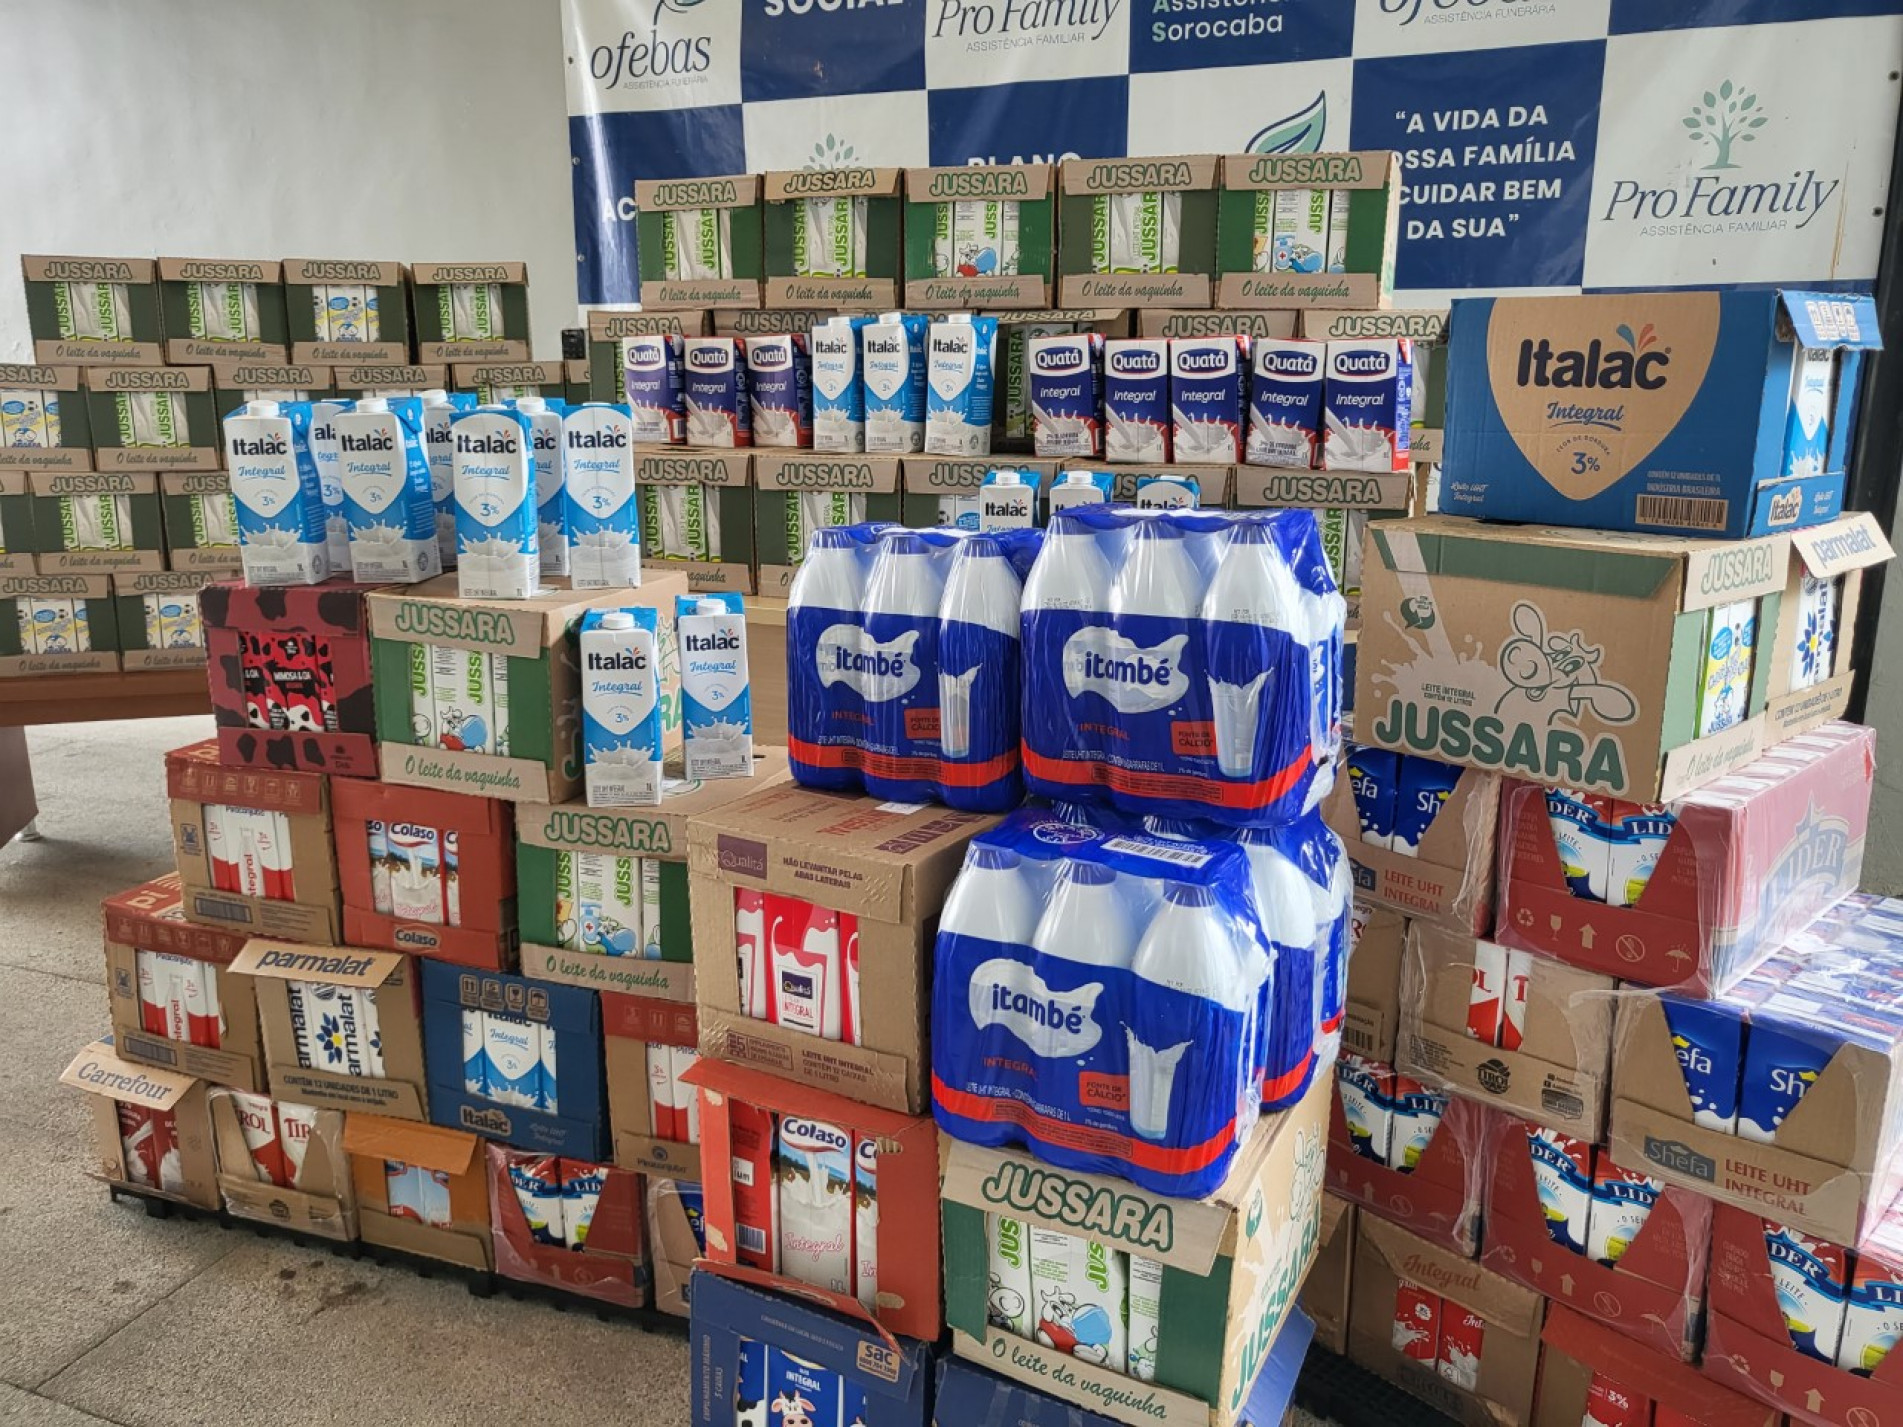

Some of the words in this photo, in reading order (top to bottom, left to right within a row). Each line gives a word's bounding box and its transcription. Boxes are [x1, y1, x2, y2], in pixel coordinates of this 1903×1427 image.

[932, 0, 994, 37] Pro
[998, 0, 1120, 41] Family
[1424, 10, 1492, 24] ASSISTÊNCIA
[1496, 5, 1555, 18] FUNERÁRIA
[1152, 14, 1283, 42] Sorocaba
[966, 36, 1034, 52] ASSISTÊNCIA
[1036, 32, 1085, 46] FAMILIAR
[590, 30, 711, 90] ofebas
[623, 78, 670, 89] ASSISTÊNCIA
[1433, 108, 1499, 132] VIDA
[1509, 105, 1548, 127] DA
[1463, 136, 1576, 166] FAMÍLIA
[1087, 162, 1192, 189] JUSSARA
[1249, 157, 1362, 184] JUSSARA
[783, 171, 874, 194] JUSSARA
[930, 172, 1028, 197] JUSSARA
[1399, 182, 1496, 205] CUIDAR
[1503, 178, 1562, 200] BEM
[654, 181, 736, 206] JUSSARA
[1603, 179, 1676, 222] Pro
[1682, 170, 1839, 230] Family
[1407, 220, 1444, 239] DA
[1640, 223, 1726, 238] ASSISTÊNCIA
[1729, 219, 1788, 234] FAMILIAR
[45, 261, 132, 279] JUSSARA
[181, 262, 263, 279] JUSSARA
[302, 262, 381, 279] JUSSARA
[433, 266, 508, 282] JUSSARA
[1082, 282, 1092, 296] O
[1094, 282, 1115, 296] leite
[1119, 283, 1132, 296] da
[1134, 282, 1183, 302] vaquinha
[1242, 282, 1252, 296] O
[1255, 281, 1277, 296] leite
[1281, 283, 1295, 296] da
[1297, 282, 1350, 300] vaquinha
[605, 318, 683, 338] JUSSARA
[735, 312, 819, 333] JUSSARA
[1162, 315, 1269, 338] JUSSARA
[1329, 316, 1444, 337] JUSSARA
[628, 348, 660, 364] Quatá
[752, 348, 786, 364] Quatá
[815, 340, 847, 355] Italac
[867, 340, 900, 354] Italac
[933, 339, 968, 355] Italac
[691, 351, 727, 366] Quatá
[1036, 348, 1080, 367] Quatá
[1112, 353, 1158, 370] Quatá
[1177, 351, 1226, 369] Quatá
[1264, 353, 1314, 373] Quatá
[1336, 351, 1387, 371] Quatá
[1517, 338, 1669, 390] Italac
[105, 372, 189, 389] JUSSARA
[234, 367, 313, 385] JUSSARA
[350, 368, 427, 383] JUSSARA
[472, 368, 546, 383] JUSSARA
[1009, 330, 1025, 416] JUSSARA
[631, 380, 660, 391] Integral
[692, 382, 726, 394] Integral
[755, 381, 790, 393] Integral
[1547, 402, 1624, 425] Integral
[232, 439, 287, 456] Italac
[341, 435, 393, 452] Italac
[457, 435, 517, 454] Italac
[568, 430, 628, 449] Italac
[238, 464, 286, 477] Integral
[347, 462, 391, 475] Integral
[461, 466, 510, 478] Integral
[573, 459, 620, 472] Integral
[639, 459, 728, 482] JUSSARA
[1571, 452, 1600, 474] 3%
[50, 475, 135, 492] JUSSARA
[776, 463, 873, 488] JUSSARA
[1262, 475, 1381, 503] JUSSARA
[985, 503, 1028, 517] Italac
[1770, 499, 1800, 522] Italac
[1811, 525, 1877, 569] parmalat
[1701, 544, 1772, 595] JUSSARA
[3, 577, 88, 594] JUSSARA
[134, 573, 215, 590] JUSSARA
[396, 601, 514, 645] JUSSARA
[687, 635, 740, 651] Italac
[588, 653, 646, 670] Italac
[689, 660, 736, 671] Integral
[836, 644, 905, 678] itambé
[1084, 650, 1171, 686] itambé
[592, 681, 642, 693] Integral
[1422, 683, 1441, 693] LEITE
[1442, 686, 1475, 700] INTEGRAL
[1374, 699, 1626, 792] JUSSARA
[405, 755, 415, 775] O
[418, 755, 445, 780] leite
[446, 761, 462, 781] da
[465, 766, 520, 792] vaquinha
[390, 823, 435, 841] Colaso
[544, 812, 671, 851] JUSSARA
[720, 849, 764, 871] Qualitá
[783, 856, 799, 866] NÃO
[799, 860, 837, 876] LEVANTAR
[838, 869, 863, 881] PELAS
[815, 873, 851, 889] LATERAIS
[1384, 870, 1415, 889] LEITE
[1417, 878, 1444, 897] UHT
[1384, 887, 1441, 915] INTEGRAL
[395, 928, 438, 946] Colaso
[257, 949, 375, 977] parmalat
[547, 954, 557, 972] O
[560, 959, 586, 976] leite
[588, 964, 606, 982] da
[609, 970, 669, 990] vaquinha
[992, 983, 1084, 1034] itambé
[490, 1028, 529, 1046] Integral
[802, 1050, 822, 1061] LEITE
[78, 1062, 172, 1100] Carrefour
[462, 1108, 508, 1132] Italac
[783, 1117, 848, 1149] Colaso
[1647, 1141, 1708, 1178] Shefa
[1726, 1159, 1767, 1182] LEITE
[1773, 1174, 1811, 1195] UHT
[982, 1160, 1175, 1252] JUSSARA
[1726, 1178, 1806, 1215] INTEGRAL
[1771, 1240, 1824, 1278] DER
[1403, 1254, 1482, 1291] Integral
[866, 1343, 893, 1366] sac
[785, 1371, 821, 1391] INTEGRAL
[992, 1338, 1007, 1357] O
[1012, 1348, 1049, 1376] leite
[1052, 1365, 1076, 1386] da
[1080, 1376, 1168, 1420] vaquinha
[1608, 1390, 1629, 1407] 3%
